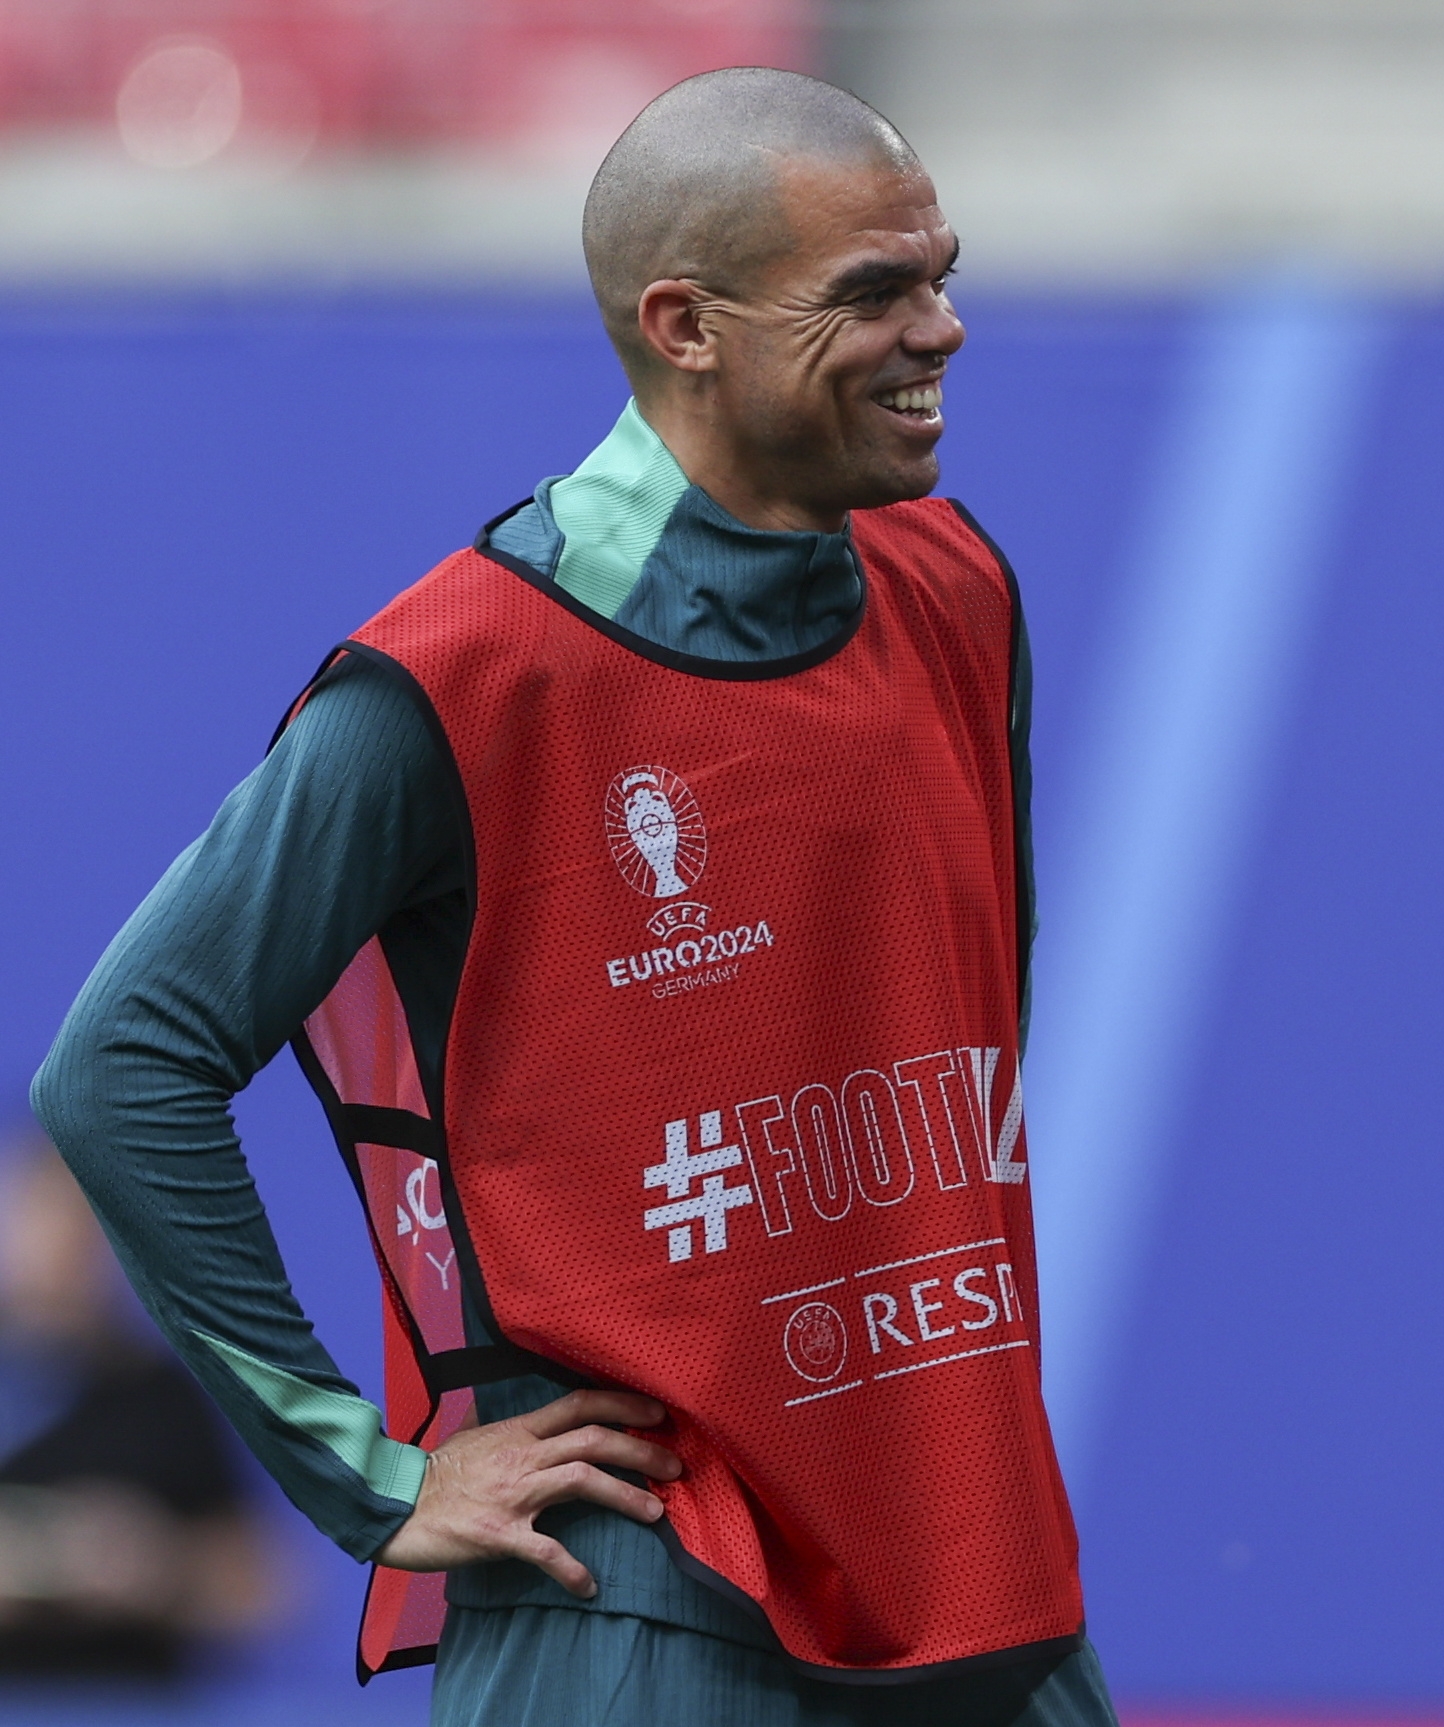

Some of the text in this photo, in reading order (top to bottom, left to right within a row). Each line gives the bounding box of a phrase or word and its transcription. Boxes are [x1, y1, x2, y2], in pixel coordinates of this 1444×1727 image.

[651, 907, 707, 937] UEFA
[606, 920, 774, 988] EURO2024
[651, 962, 741, 999] GERMANY
[793, 1308, 831, 1329] UEFA
